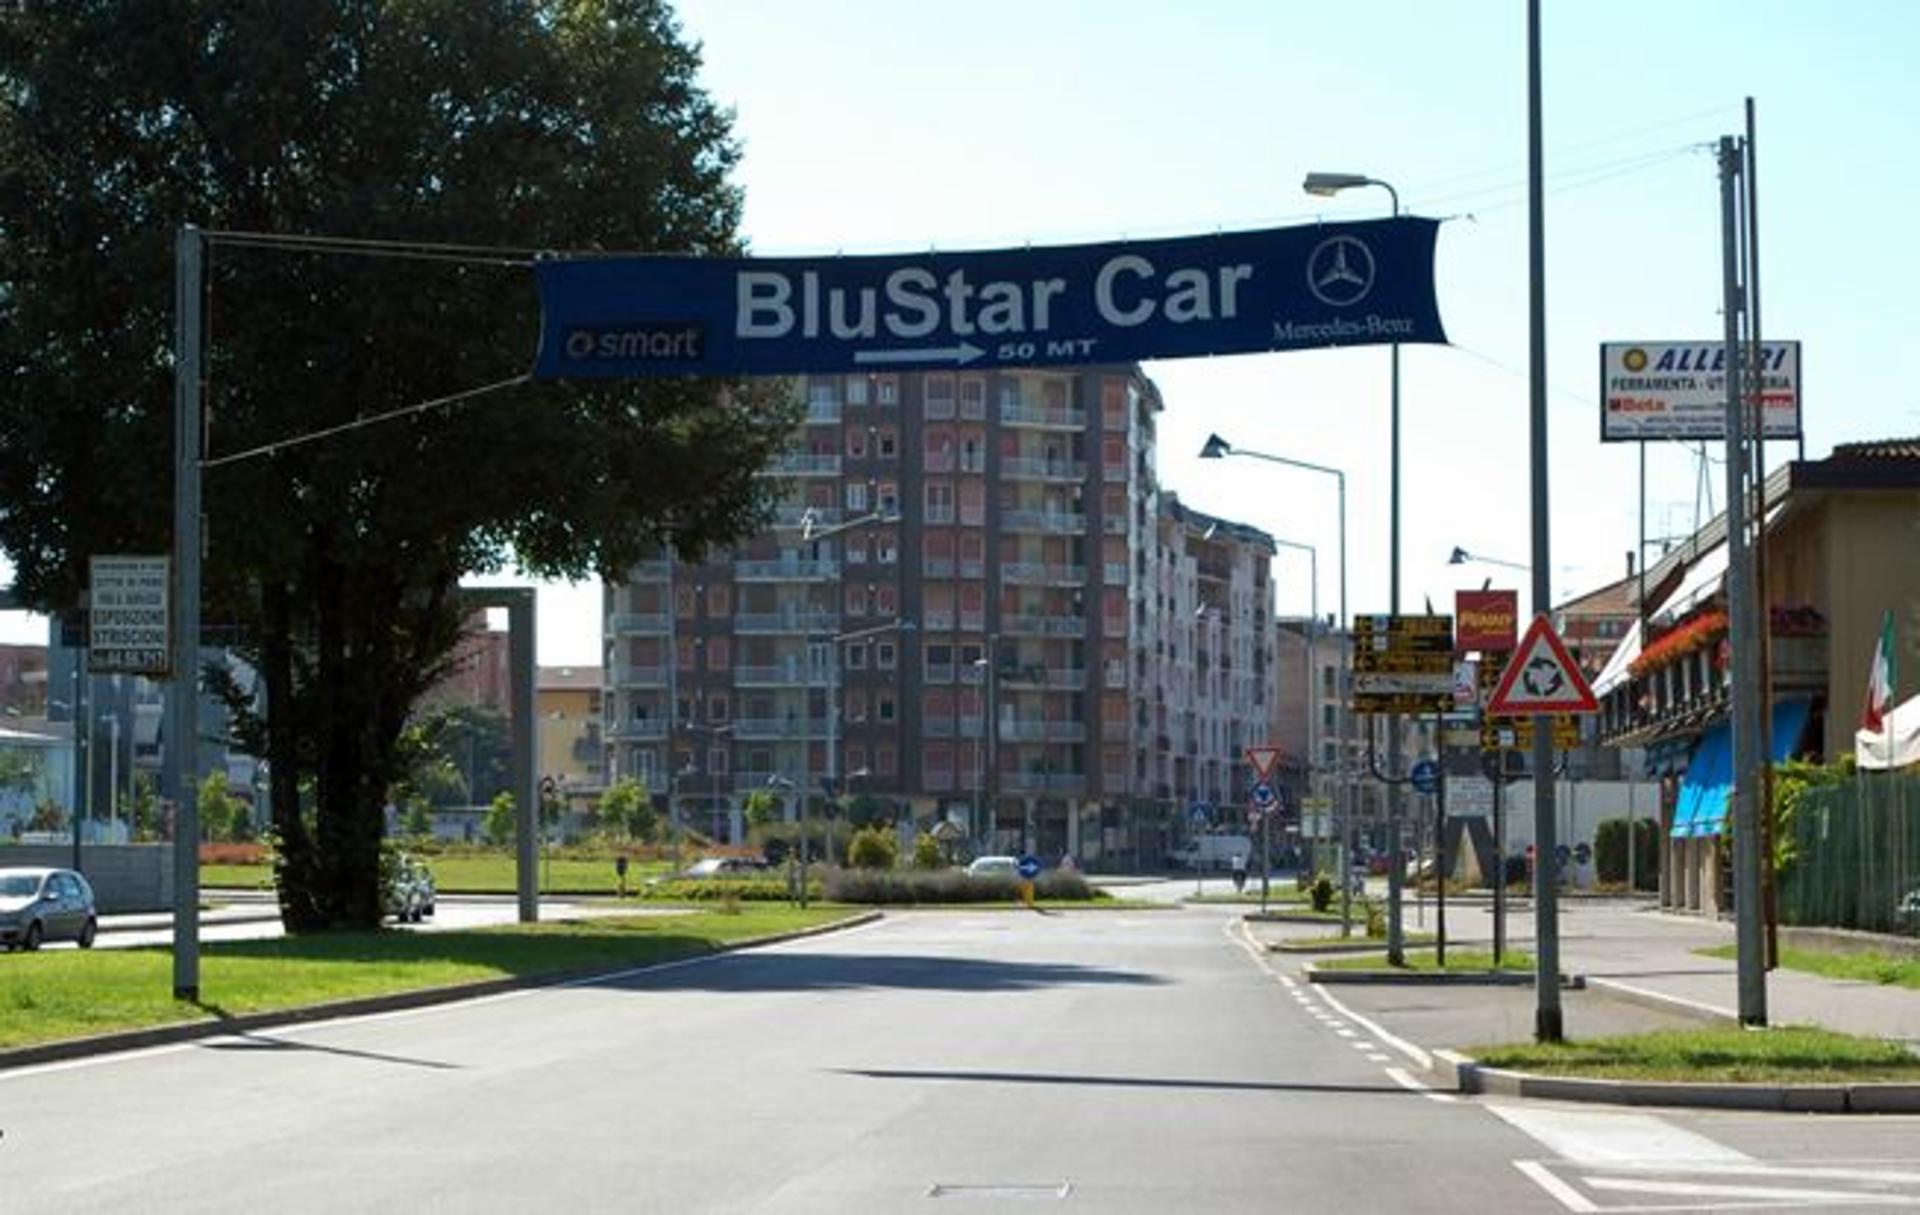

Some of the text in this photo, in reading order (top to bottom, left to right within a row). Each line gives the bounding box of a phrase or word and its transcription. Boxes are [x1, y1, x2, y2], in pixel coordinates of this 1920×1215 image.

[736, 254, 1254, 340] BluStar Car
[1272, 314, 1415, 341] Mercedes-Benz
[599, 328, 698, 358] smart
[998, 338, 1098, 359] 50 MT
[1655, 348, 1787, 371] ALLERI
